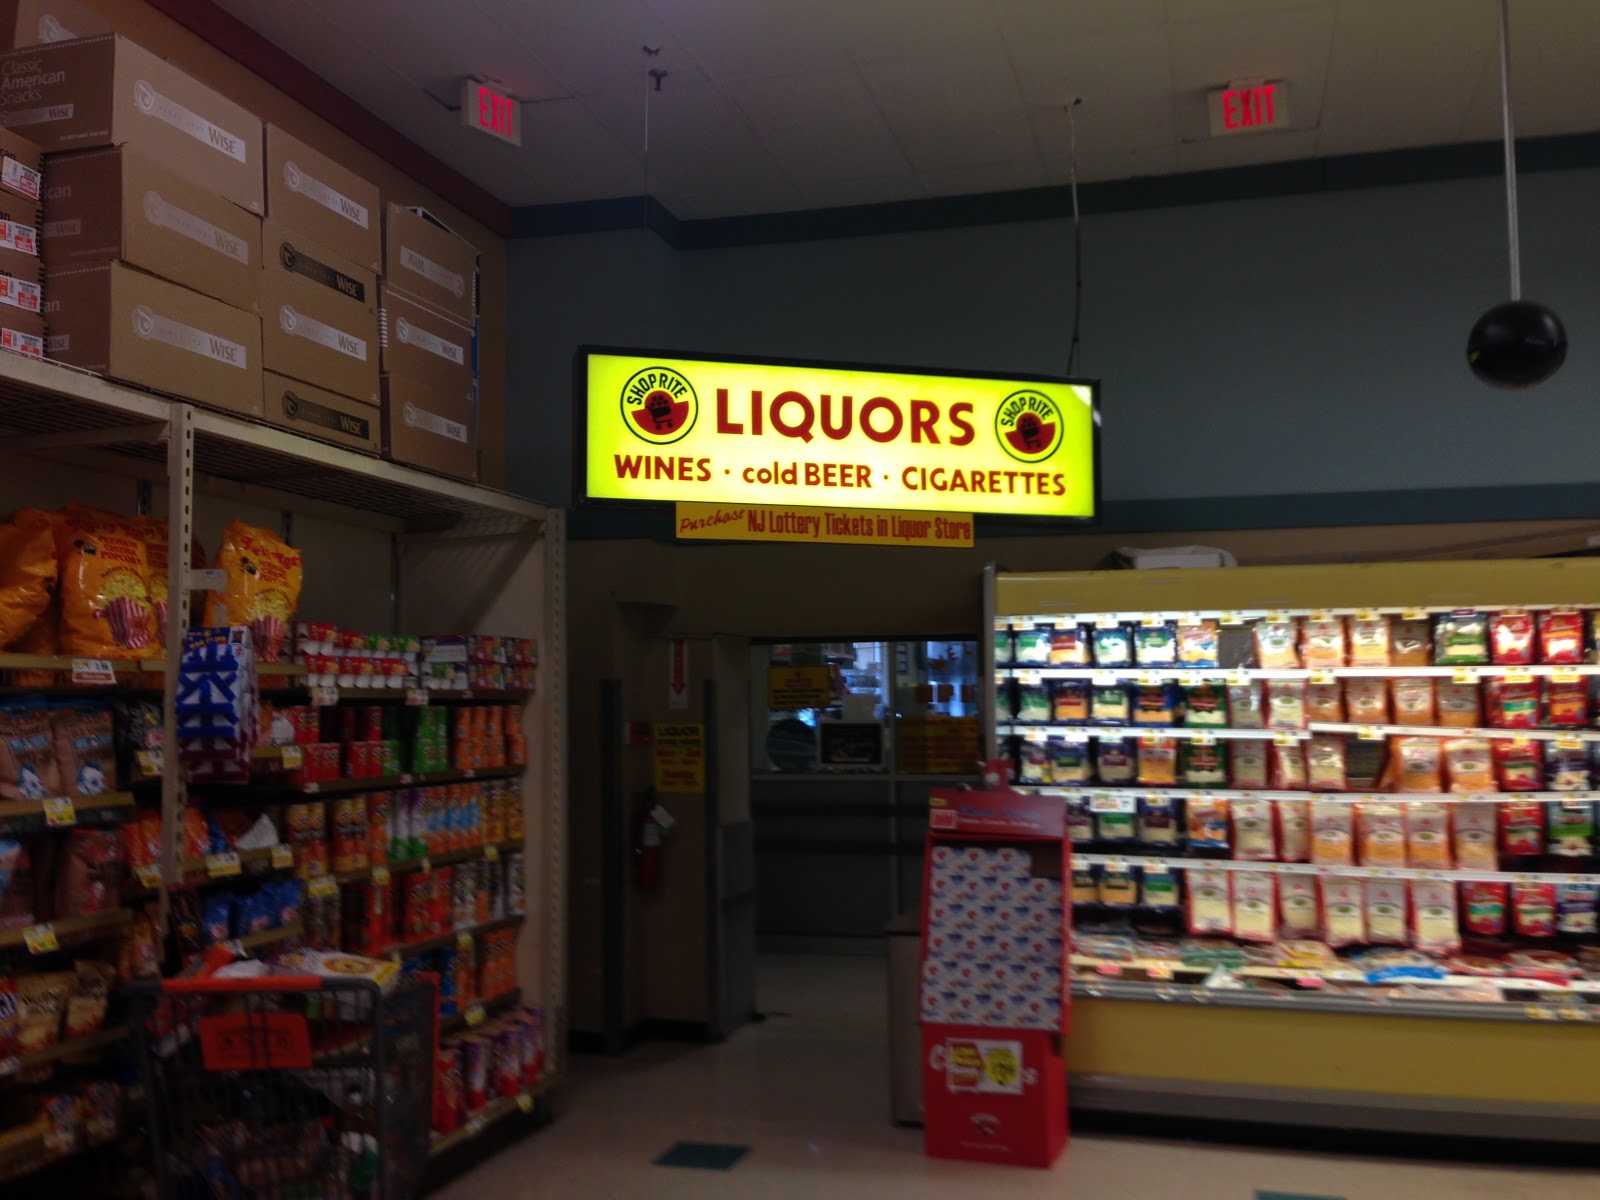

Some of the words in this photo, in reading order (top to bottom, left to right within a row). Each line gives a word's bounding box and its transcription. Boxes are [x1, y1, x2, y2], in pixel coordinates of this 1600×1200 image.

[0, 70, 65, 91] American
[479, 86, 514, 138] EXIT
[1223, 84, 1276, 129] EXIT
[716, 388, 975, 447] LIQUORS
[614, 454, 712, 482] WINES
[901, 466, 1066, 496] CIGARETTES
[680, 509, 745, 533] Purchase
[747, 510, 765, 532] NJ
[769, 510, 820, 538] Lottery
[824, 512, 874, 537] Tickets
[876, 515, 888, 537] in
[892, 515, 931, 541] Liquor
[934, 517, 971, 540] Store
